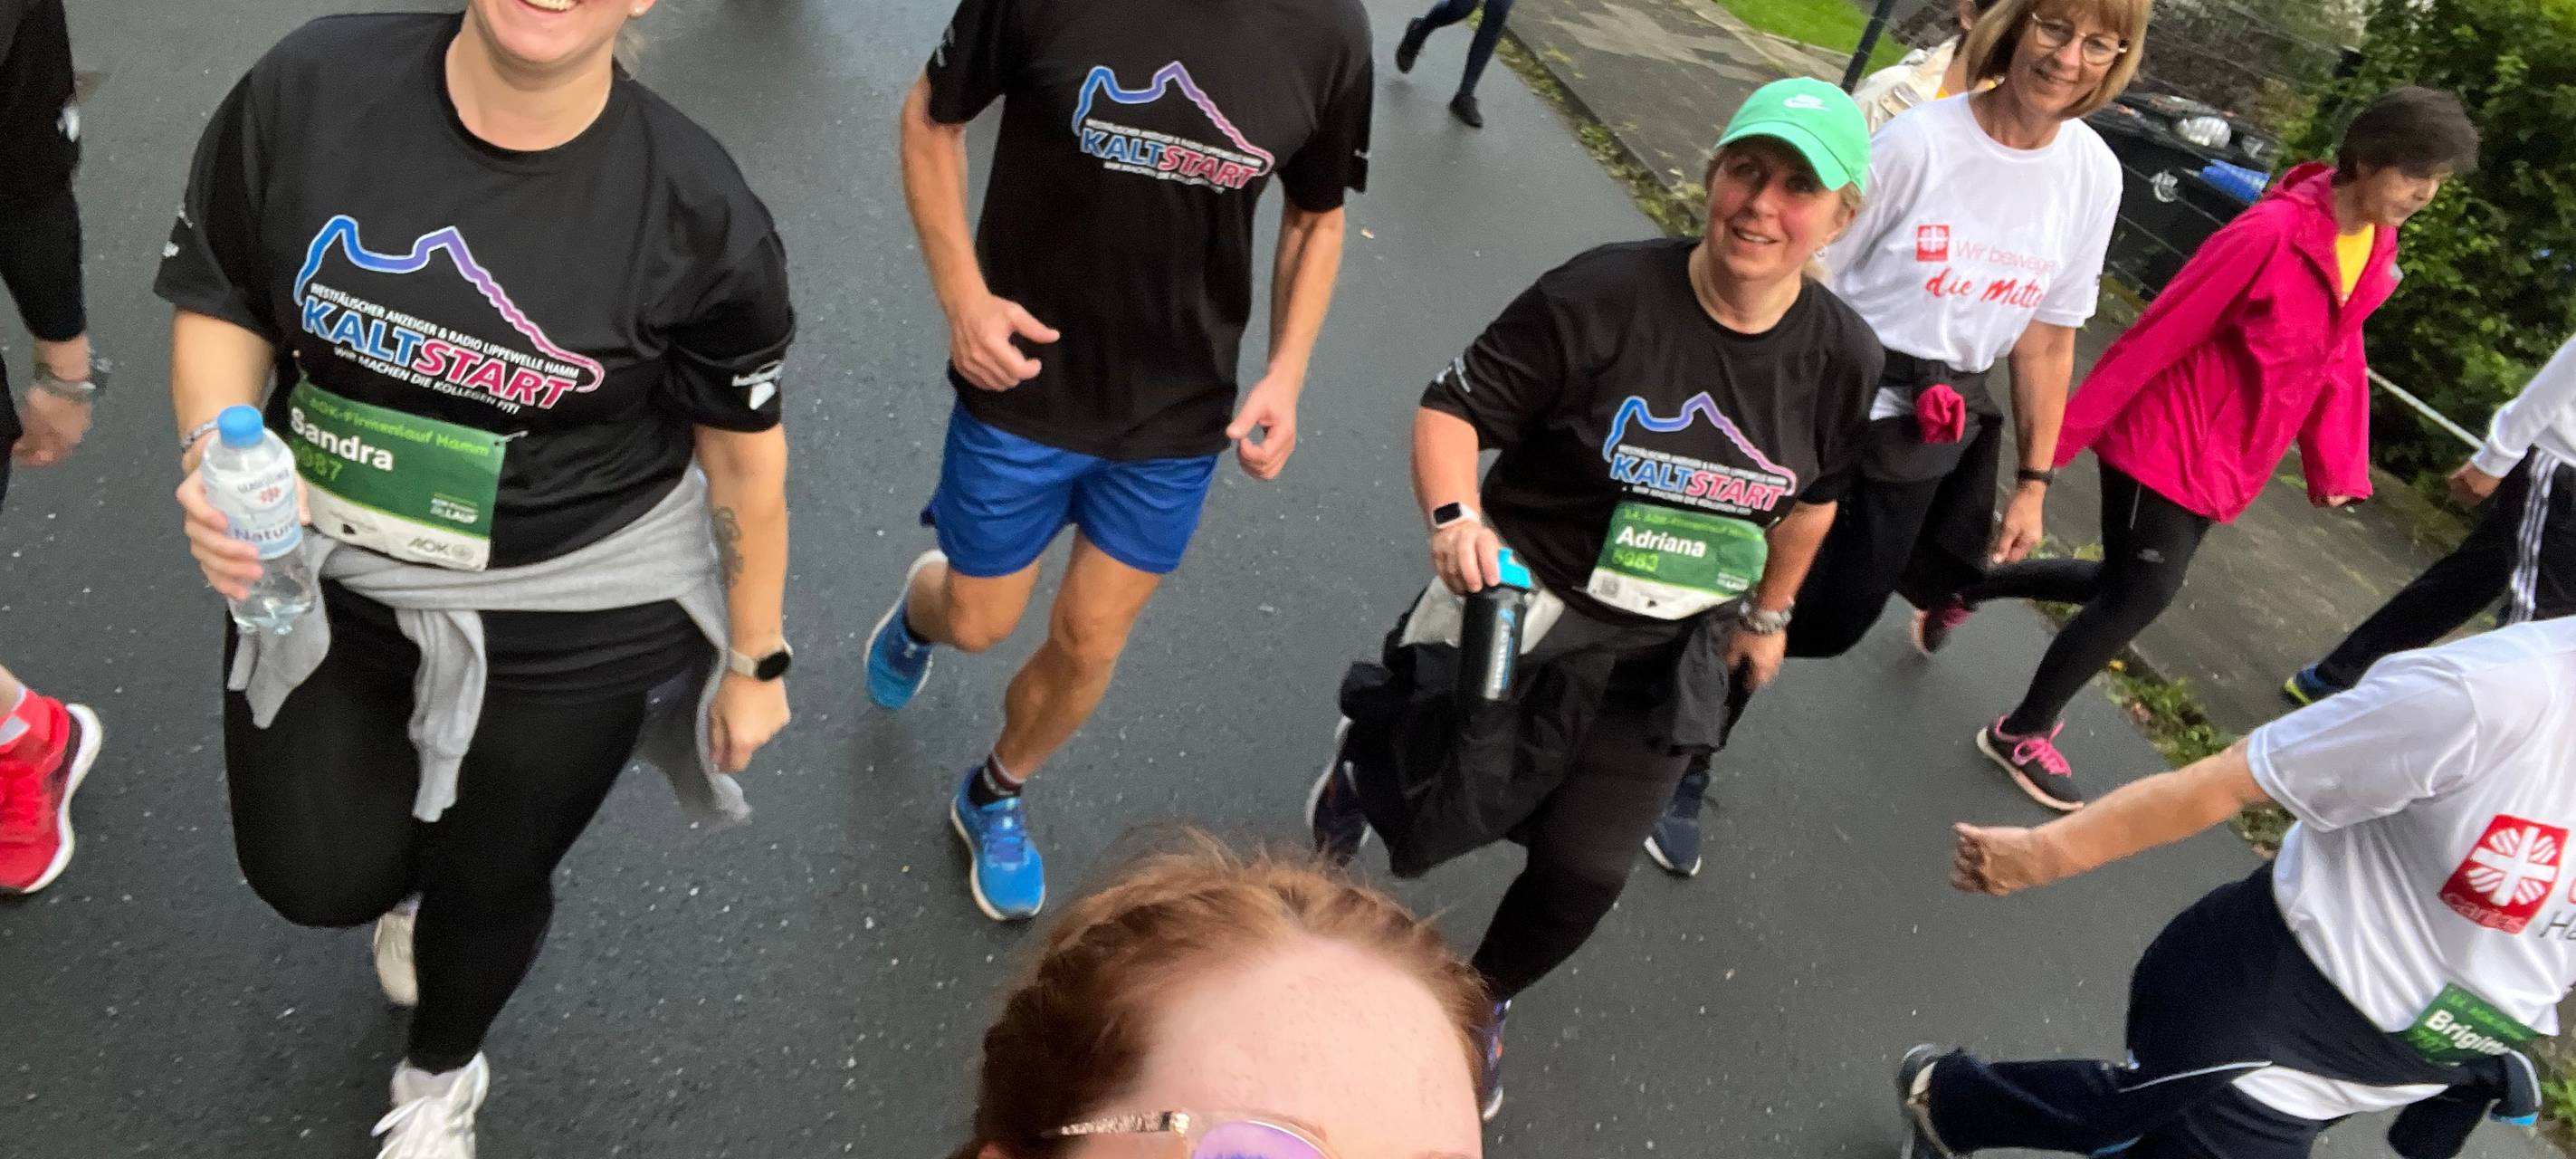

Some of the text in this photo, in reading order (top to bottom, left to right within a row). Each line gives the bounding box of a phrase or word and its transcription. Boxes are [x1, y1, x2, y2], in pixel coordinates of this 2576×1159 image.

[1080, 127, 1259, 189] KALTSTART
[1925, 267, 1974, 297] die
[301, 294, 577, 410] KALTSTART
[386, 310, 438, 336] ANZEIGER
[438, 327, 447, 340] &
[448, 330, 482, 351] RADIO
[483, 341, 544, 370] LIPPEWELLE
[544, 362, 580, 379] HAMM
[358, 356, 408, 380] MACHEN
[410, 371, 431, 388] DIE
[434, 379, 497, 406] KOLLEGEN
[291, 407, 394, 472] Sandra
[1609, 453, 1786, 512] KALTSTART
[1615, 525, 1707, 559] Adriana
